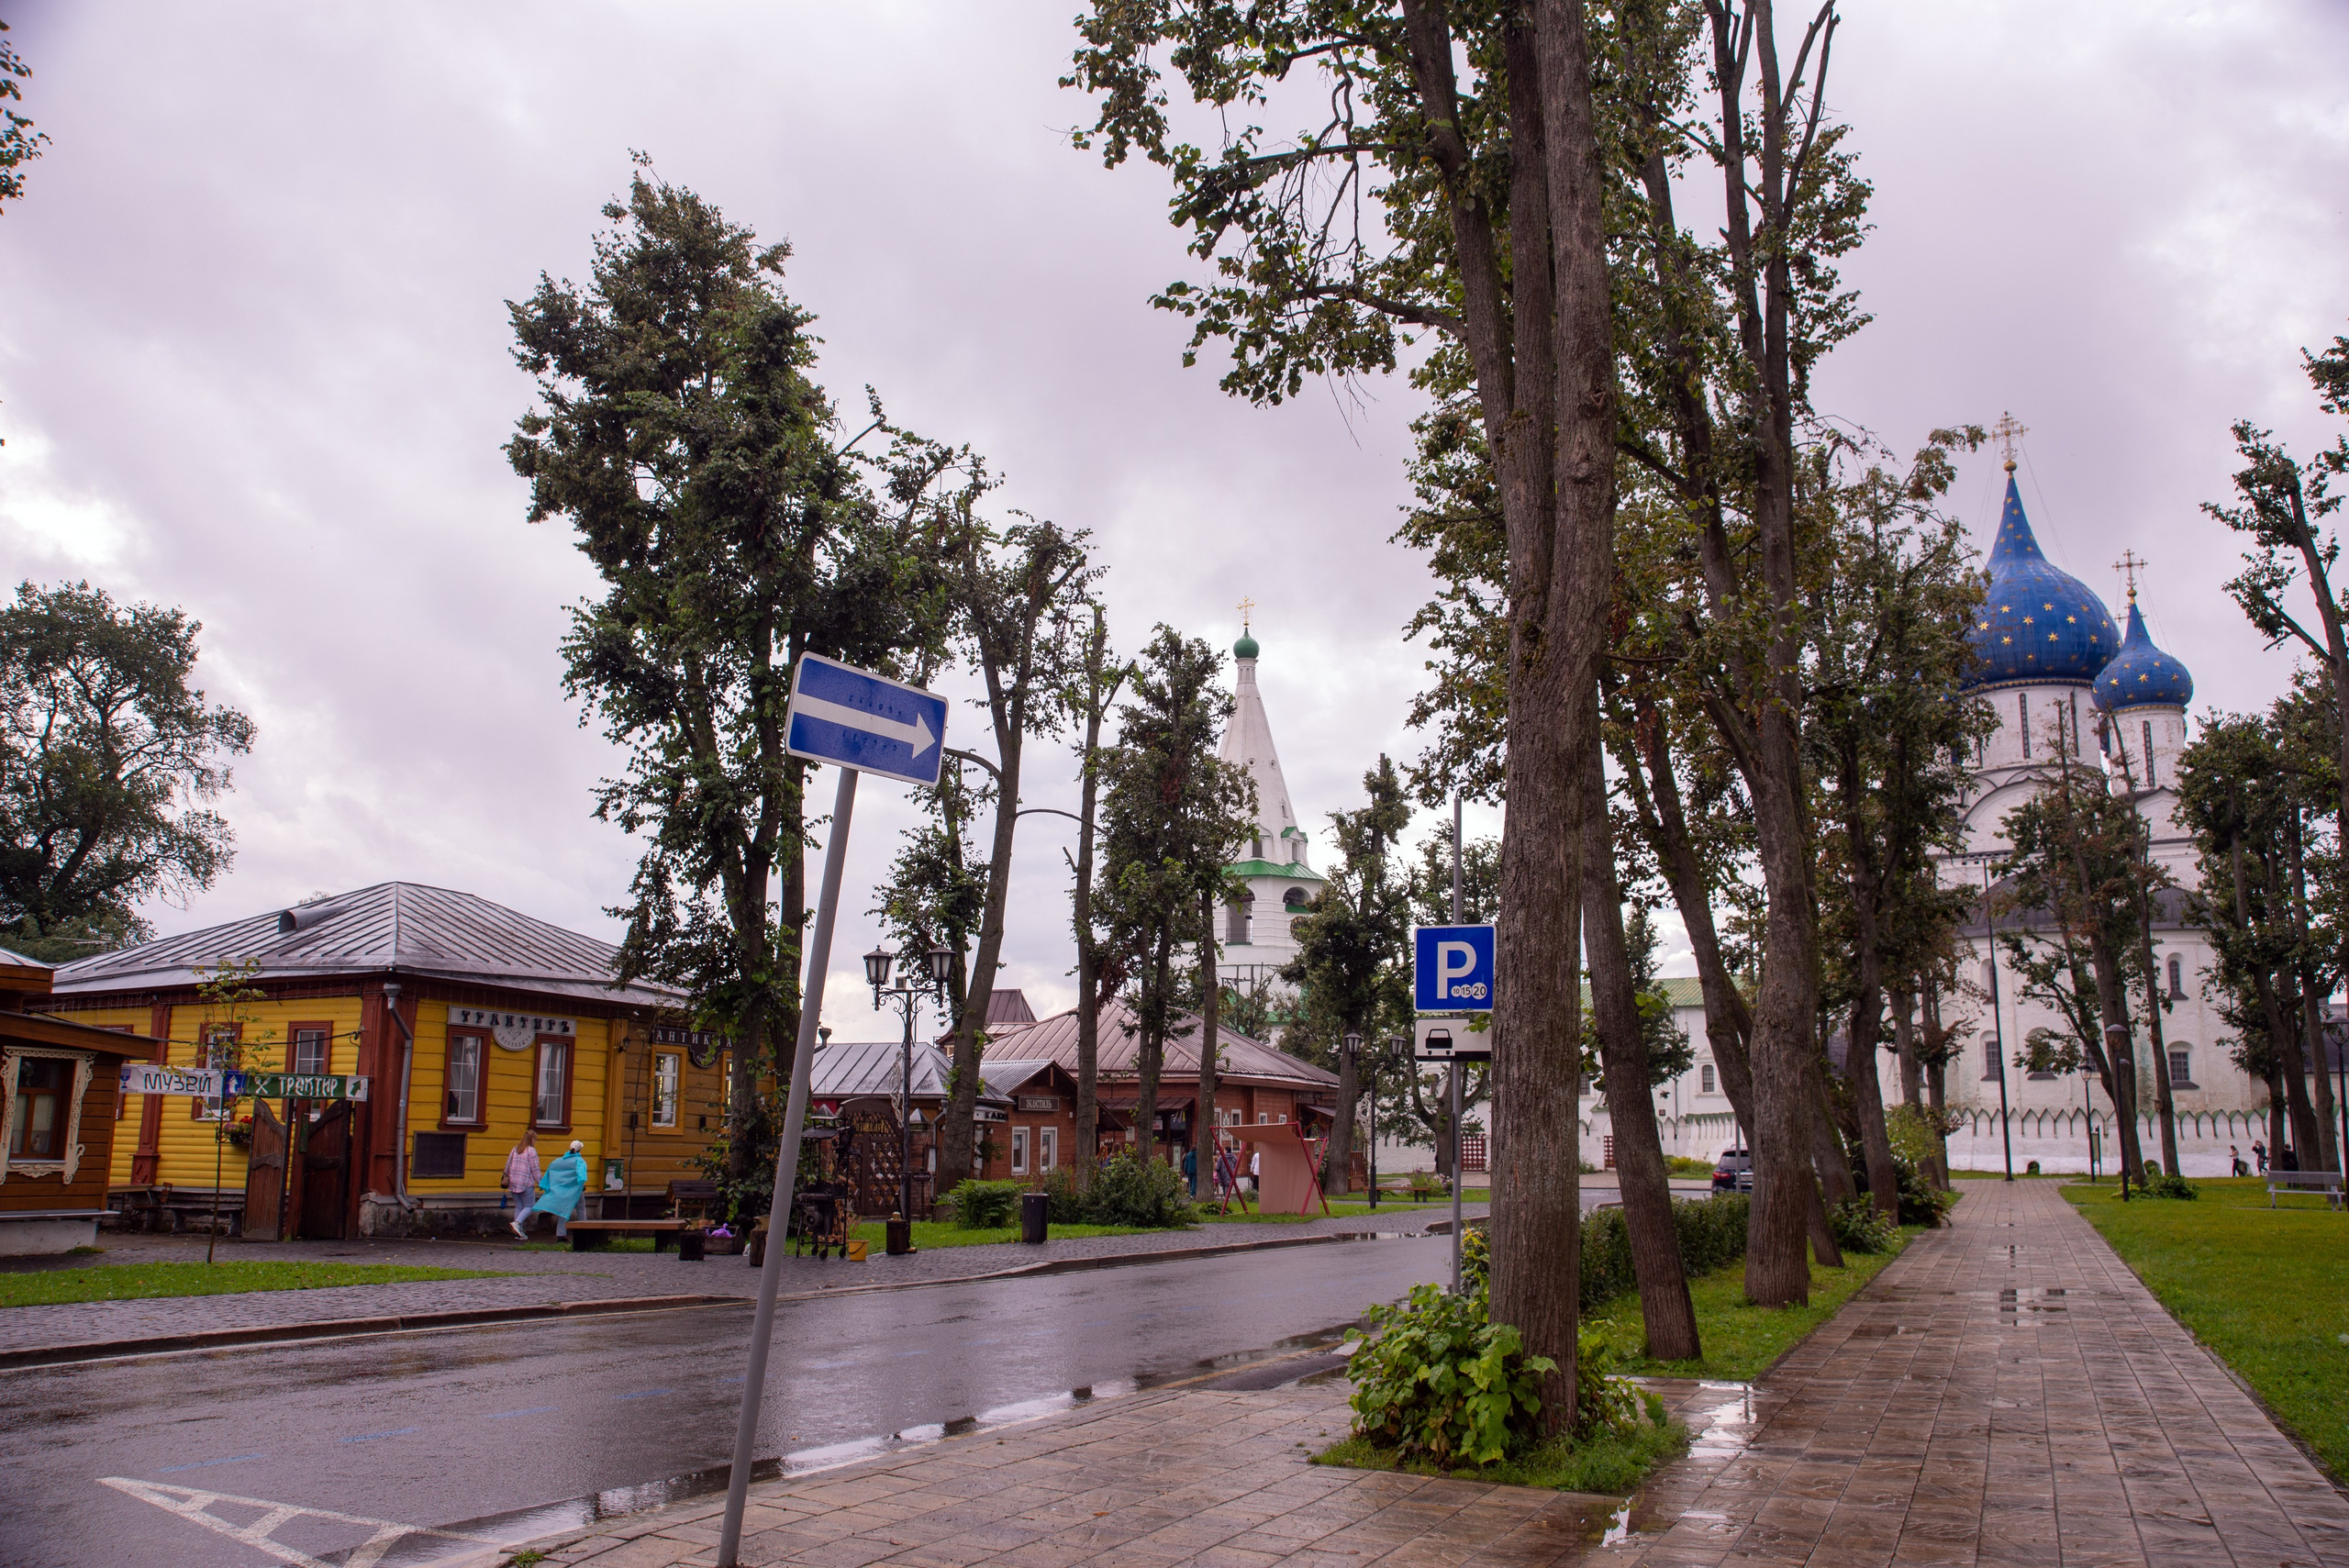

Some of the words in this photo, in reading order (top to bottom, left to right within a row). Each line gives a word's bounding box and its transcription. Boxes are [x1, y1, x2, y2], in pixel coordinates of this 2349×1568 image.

[1437, 940, 1477, 999] P
[1462, 986, 1471, 995] 15
[1473, 985, 1486, 996] 20
[144, 1073, 212, 1093] МУЗЕЙ
[279, 1076, 339, 1096] ТРАКТИР
[1026, 1098, 1052, 1109] ЭКОСТИЛЬ
